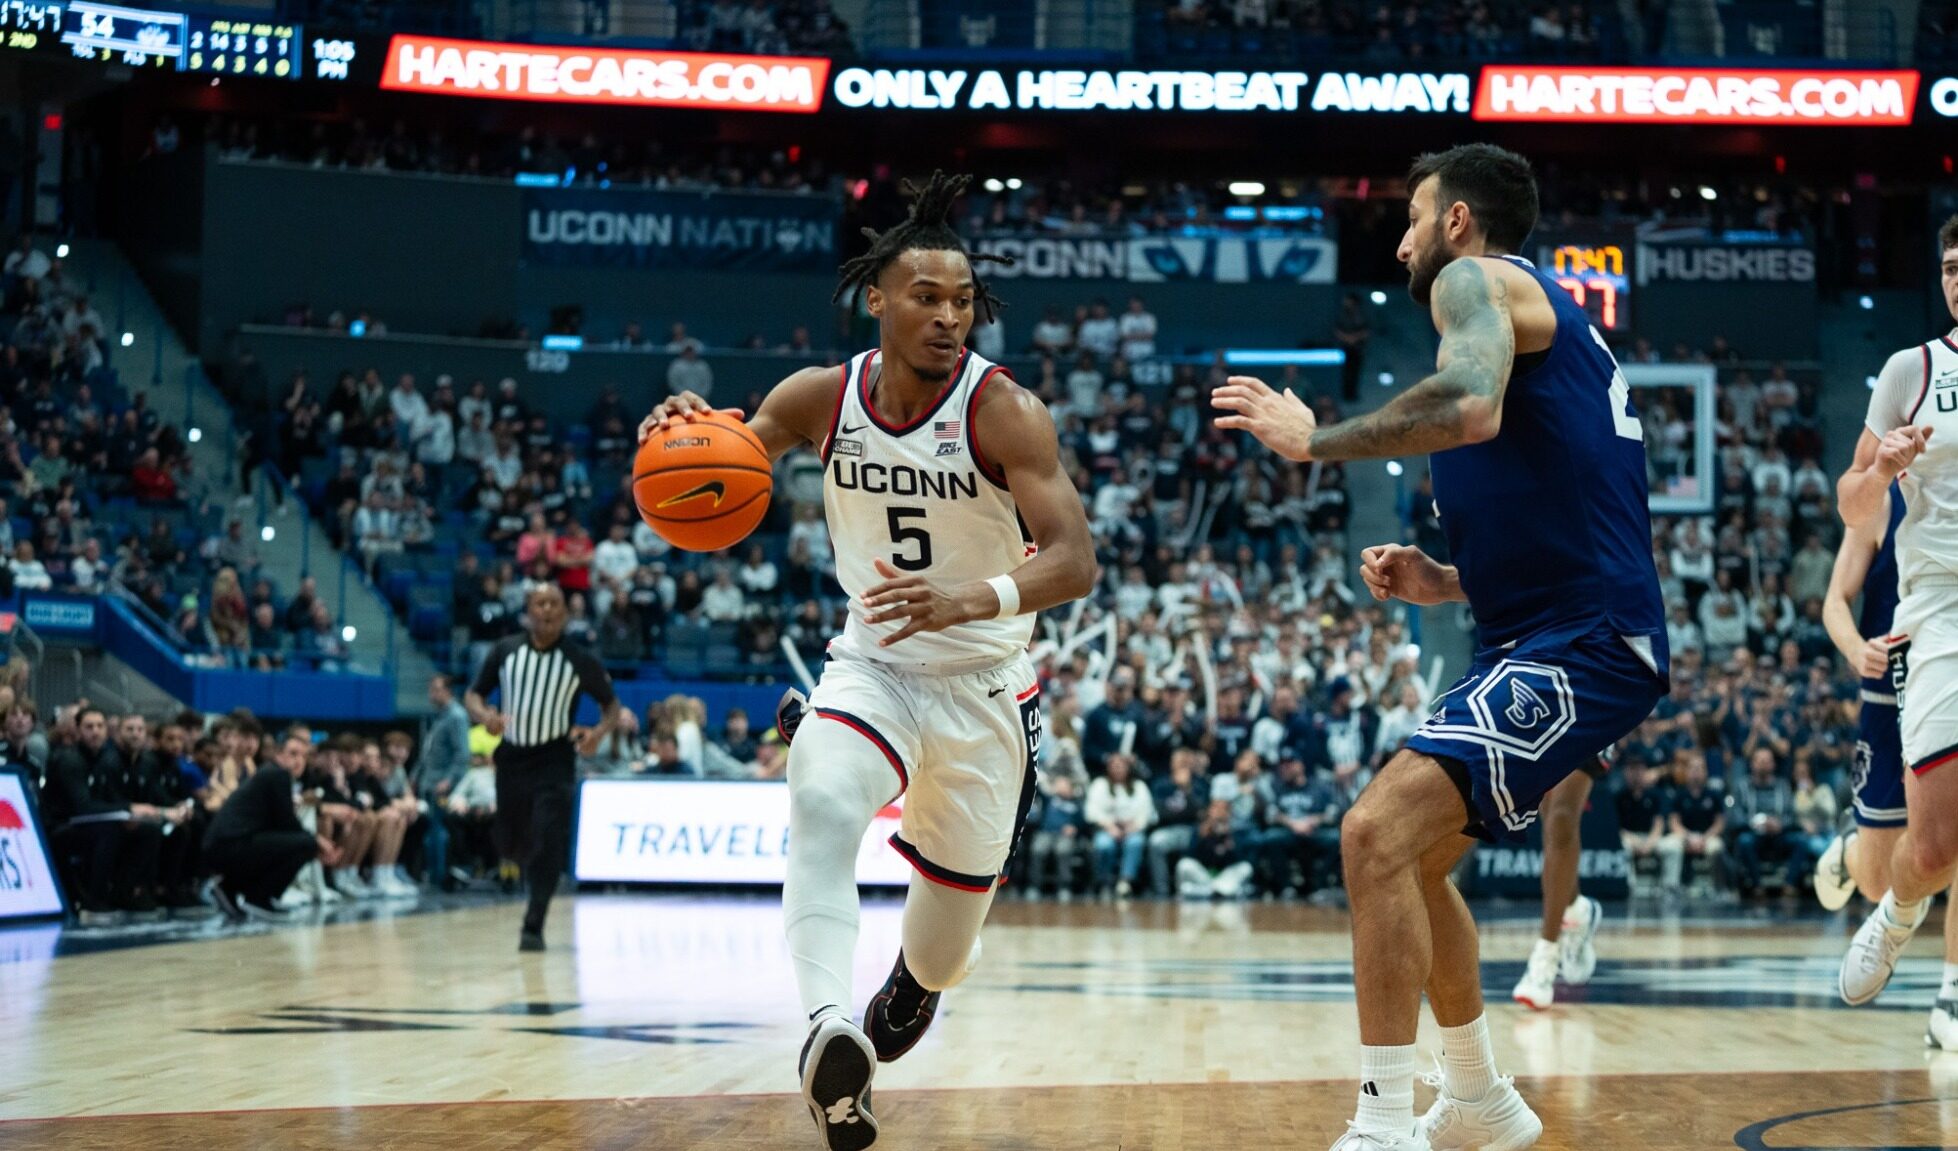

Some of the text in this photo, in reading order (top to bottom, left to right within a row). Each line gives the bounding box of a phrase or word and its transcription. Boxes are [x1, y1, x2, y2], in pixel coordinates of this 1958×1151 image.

[0, 1, 61, 32] 17:47
[80, 12, 115, 38] 54
[313, 38, 355, 61] 1:05
[318, 59, 348, 79] PM
[398, 43, 815, 105] HARTECARS.COM
[834, 67, 1470, 113] ONLY A HEARTBEAT AWAY!
[1490, 74, 1905, 118] HARTECARS.COM
[528, 210, 673, 247] UCONN
[1555, 246, 1623, 275] 17:47
[1650, 248, 1815, 281] HUSKIES
[664, 436, 711, 451] UCONN
[833, 459, 978, 500] UCONN
[887, 506, 932, 571] 5
[1477, 850, 1628, 878] TRAVERS
